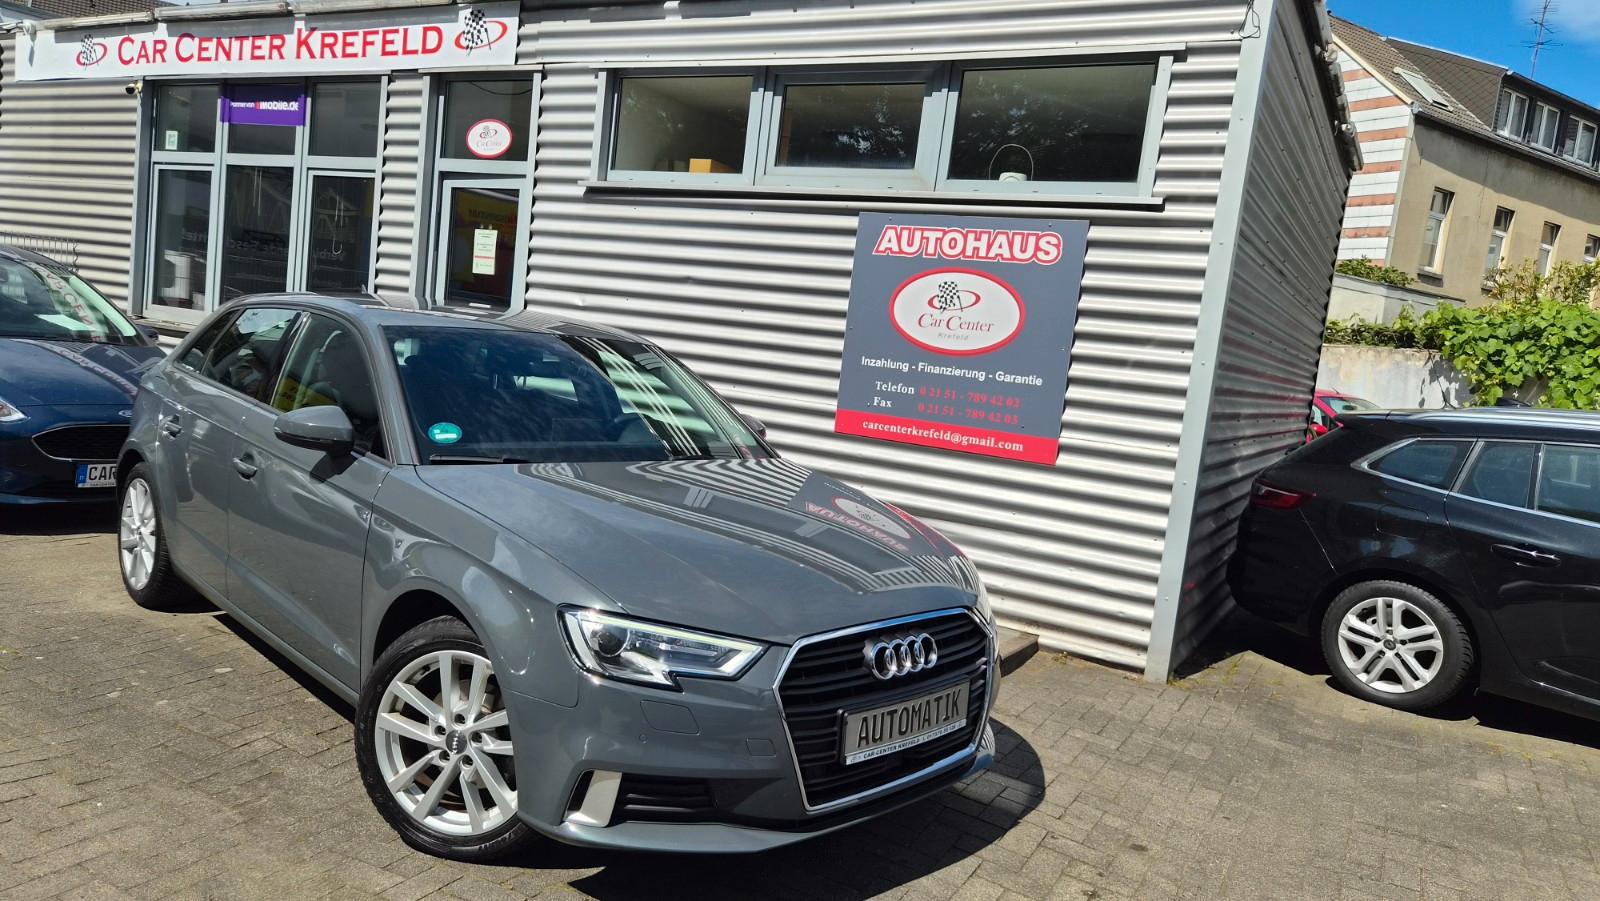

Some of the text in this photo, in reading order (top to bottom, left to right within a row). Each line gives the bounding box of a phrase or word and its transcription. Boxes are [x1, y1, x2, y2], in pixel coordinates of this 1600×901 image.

[117, 25, 443, 66] CAR CENTER KREFELD
[873, 224, 1063, 265] AUTOHAUS
[917, 312, 995, 333] Car Center
[938, 332, 969, 341] Krefeld
[861, 355, 909, 373] Inzahlung
[918, 362, 986, 382] Finanzierung
[995, 371, 1044, 386] Garantie
[873, 396, 893, 408] Fax
[875, 381, 915, 396] Telefon
[862, 421, 1024, 452] carcenterkrefeld@gmail.com
[857, 689, 962, 748] AUTOMATIK
